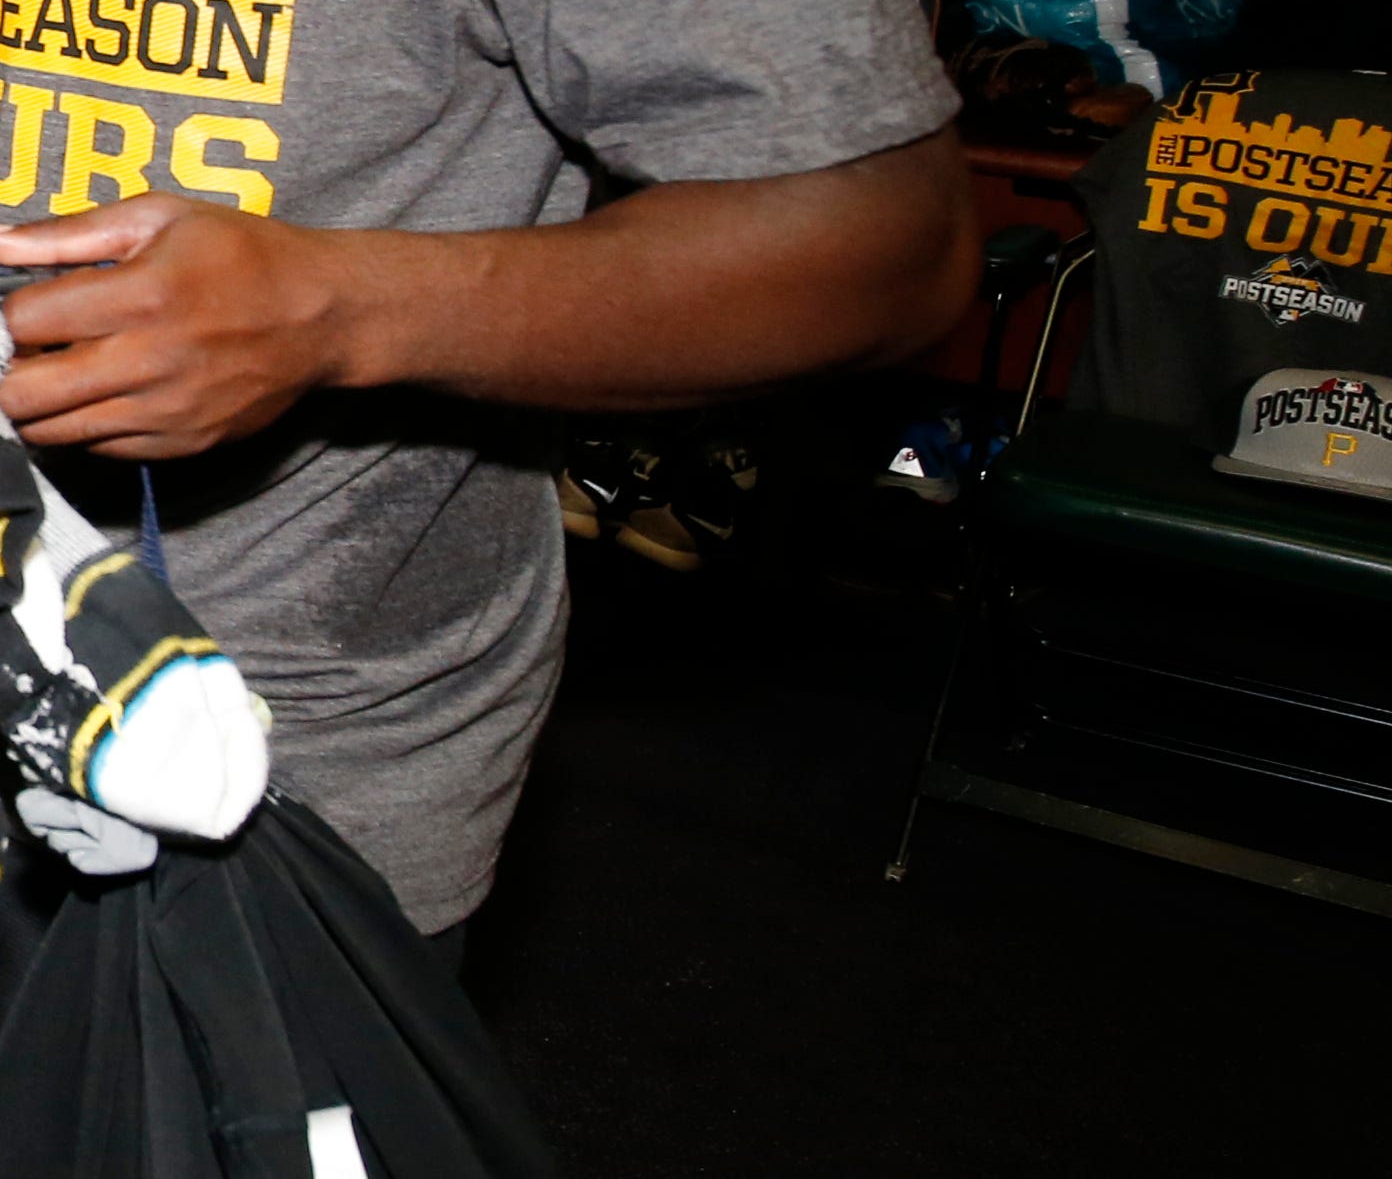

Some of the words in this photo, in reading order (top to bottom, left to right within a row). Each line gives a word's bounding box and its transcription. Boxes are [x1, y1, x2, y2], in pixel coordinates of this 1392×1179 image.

[1156, 134, 1178, 166] THE
[1138, 178, 1230, 240] IS
[1223, 277, 1365, 322] POSTSEASON
[1322, 433, 1358, 467] P
